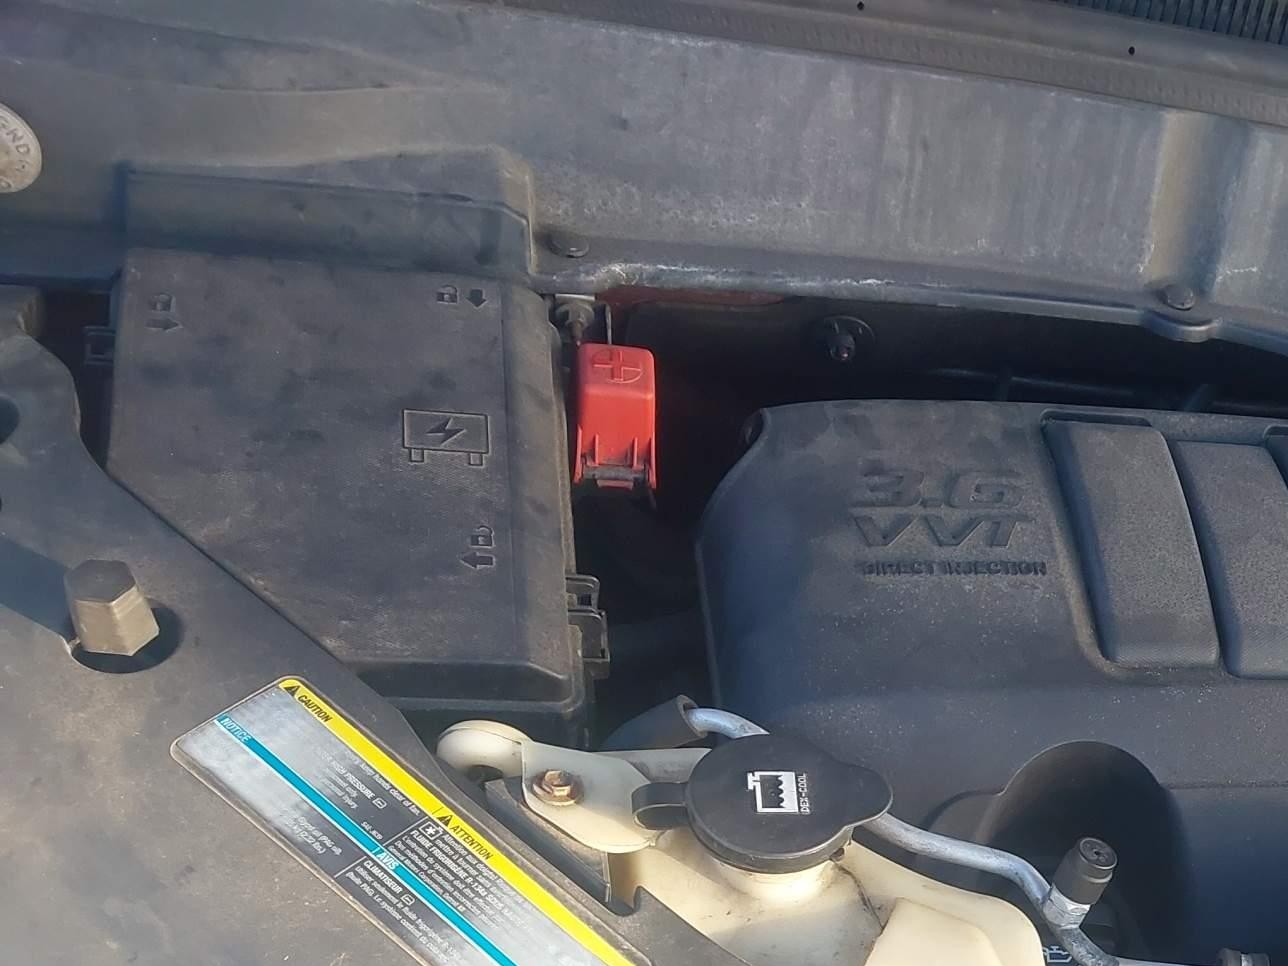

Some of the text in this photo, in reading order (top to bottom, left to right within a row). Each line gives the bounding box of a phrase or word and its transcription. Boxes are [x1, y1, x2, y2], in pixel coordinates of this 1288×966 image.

[852, 470, 1026, 508] 3.6
[852, 513, 1036, 548] VVT
[860, 560, 1048, 577] DIRECT INJECTION
[297, 695, 332, 722] CAUTION
[220, 717, 251, 742] NOTICE
[342, 772, 375, 799] PRESSURE
[372, 774, 392, 789] hands
[388, 788, 406, 801] clear
[796, 772, 811, 815] DEX-COOL
[409, 830, 432, 848] FLUIDE
[441, 833, 468, 855] Attention
[465, 854, 478, 864] aux
[449, 824, 493, 859] ATTENTION
[376, 851, 399, 869] AVIS
[434, 839, 454, 855] mettre
[457, 858, 479, 876] tourner
[363, 860, 403, 893] CLIMATISEUR
